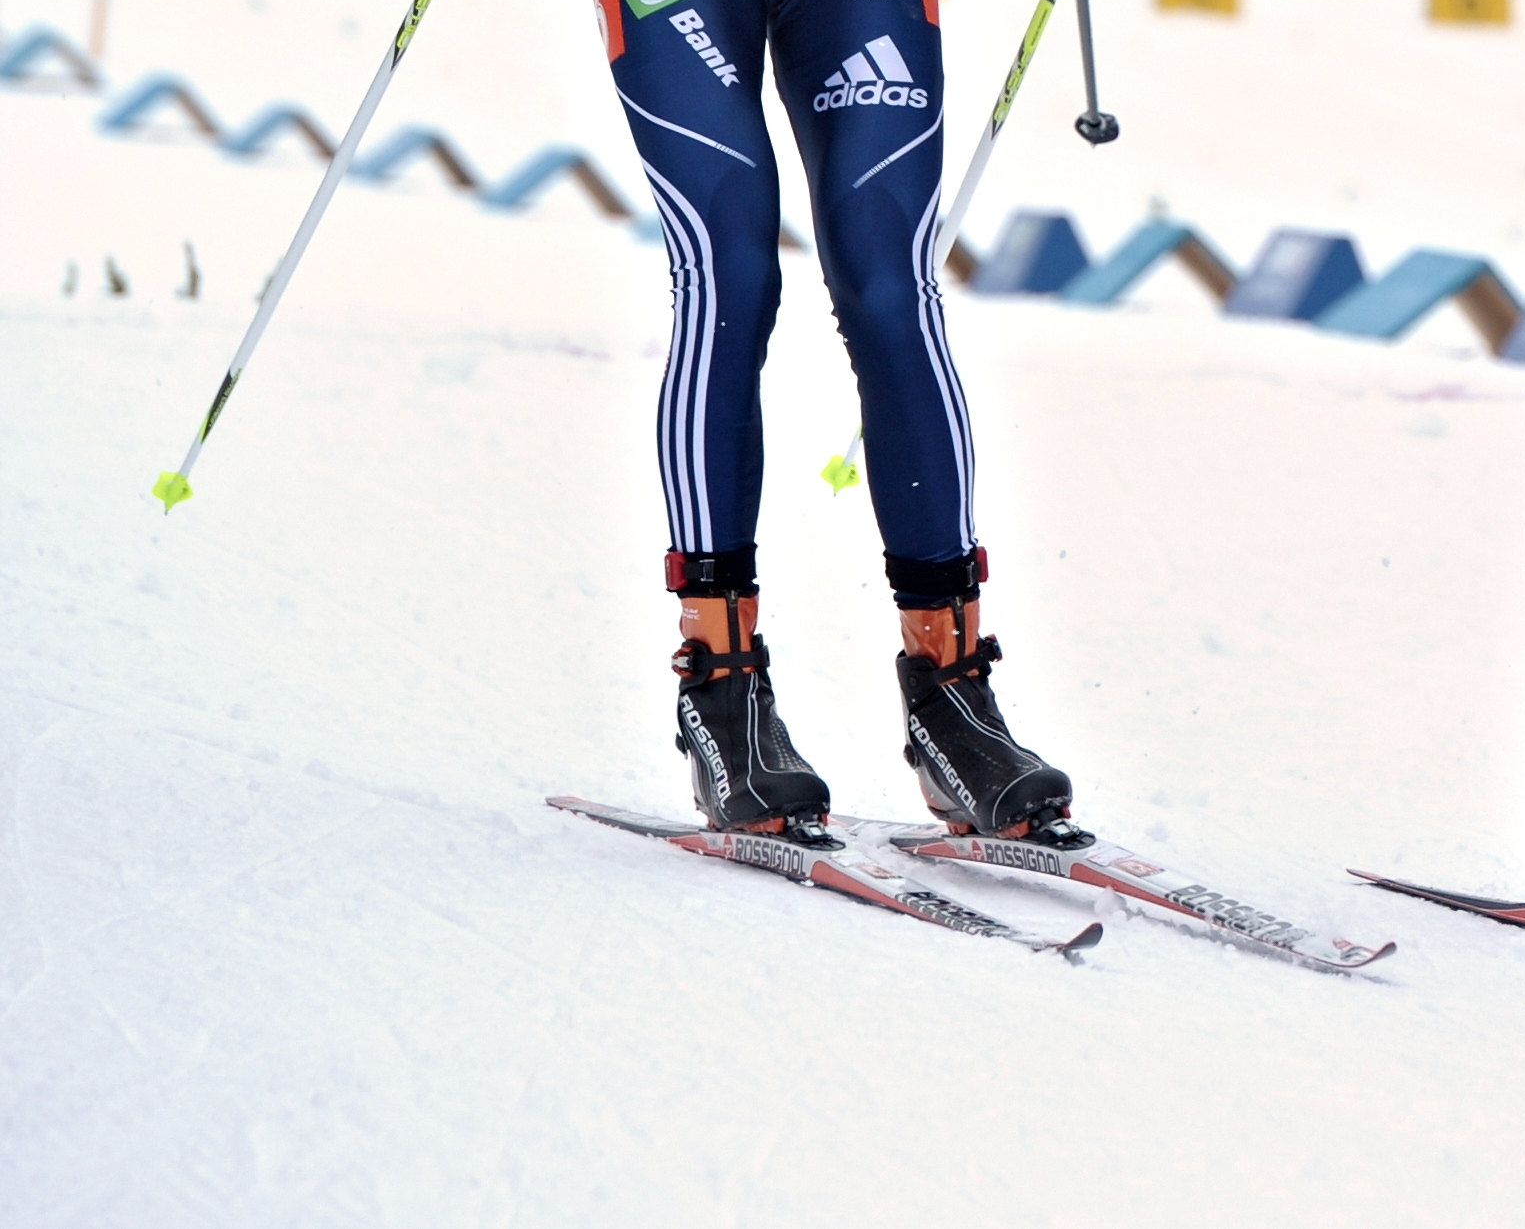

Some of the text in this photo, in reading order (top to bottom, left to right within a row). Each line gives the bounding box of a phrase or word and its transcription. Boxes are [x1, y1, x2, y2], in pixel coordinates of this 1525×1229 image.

[667, 8, 740, 88] Bank
[812, 78, 929, 113] adidas
[679, 693, 733, 810] ROSSIGNOL
[907, 714, 980, 818] ROSSIGNOL
[735, 837, 807, 877] ROSSIGNOL
[984, 842, 1067, 878] ROSSIGNOL
